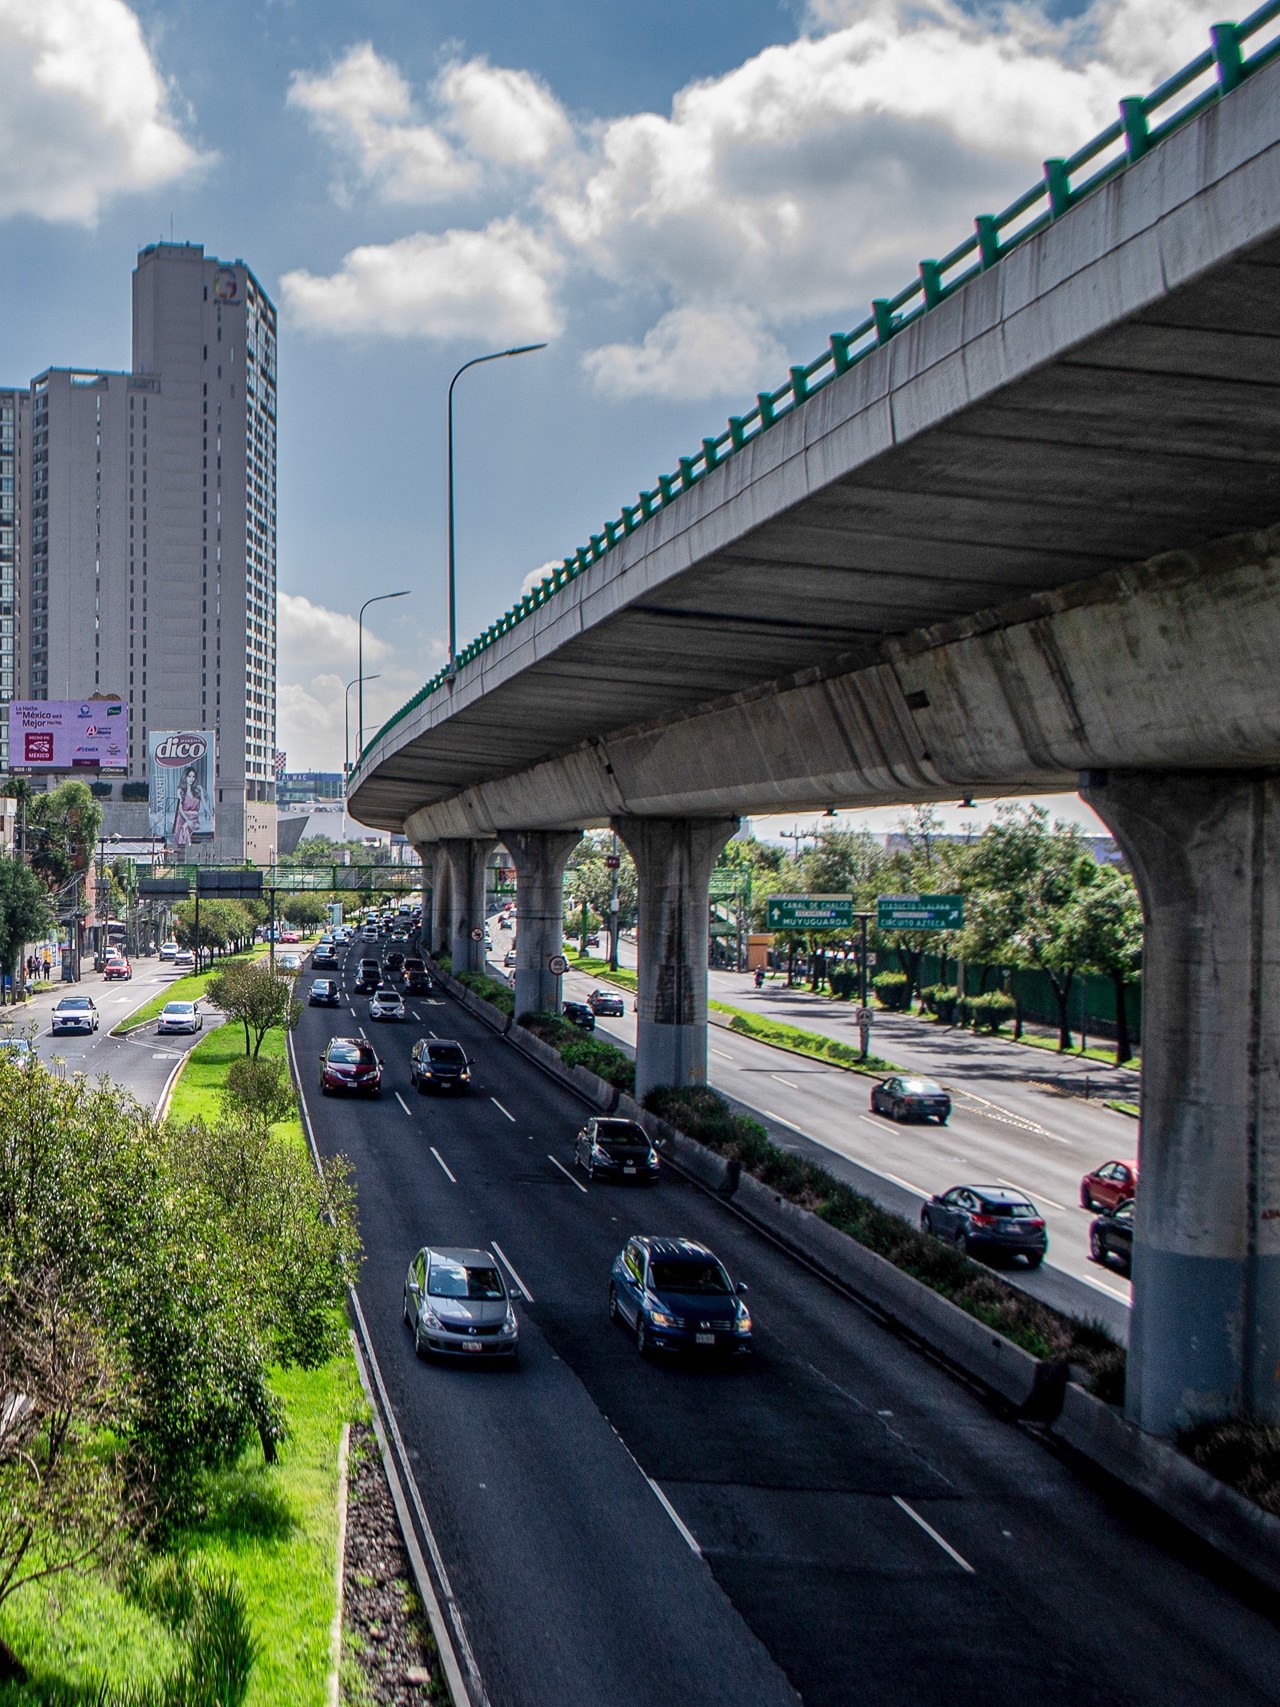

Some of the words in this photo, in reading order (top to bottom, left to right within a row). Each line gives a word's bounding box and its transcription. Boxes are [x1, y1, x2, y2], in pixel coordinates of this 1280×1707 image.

[22, 711, 51, 719] México
[22, 719, 46, 729] Mejor
[156, 737, 205, 758] dico
[782, 902, 807, 910] CANAL
[809, 902, 818, 910] DE
[821, 902, 850, 910] CHALCO
[783, 918, 849, 926] MUYUGUARDA
